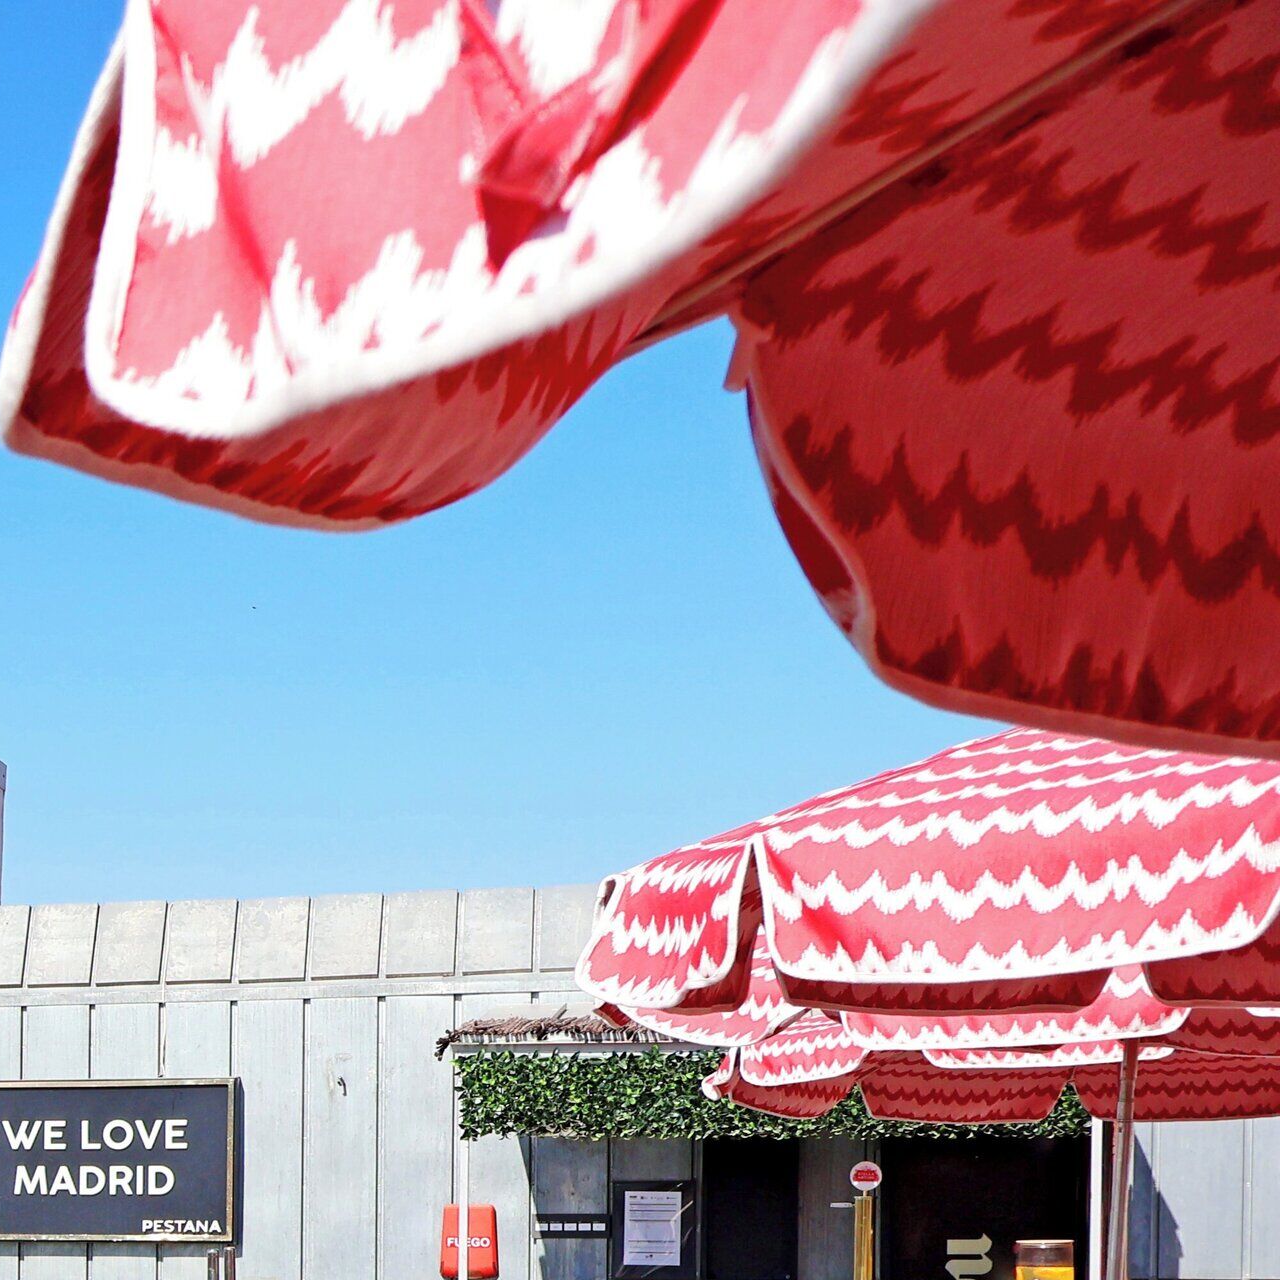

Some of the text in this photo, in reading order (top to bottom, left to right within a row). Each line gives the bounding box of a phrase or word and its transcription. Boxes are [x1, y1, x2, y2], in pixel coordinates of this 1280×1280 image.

[2, 1119, 189, 1150] WE LOVE
[14, 1165, 175, 1196] MADRID
[142, 1219, 222, 1233] PESTANA
